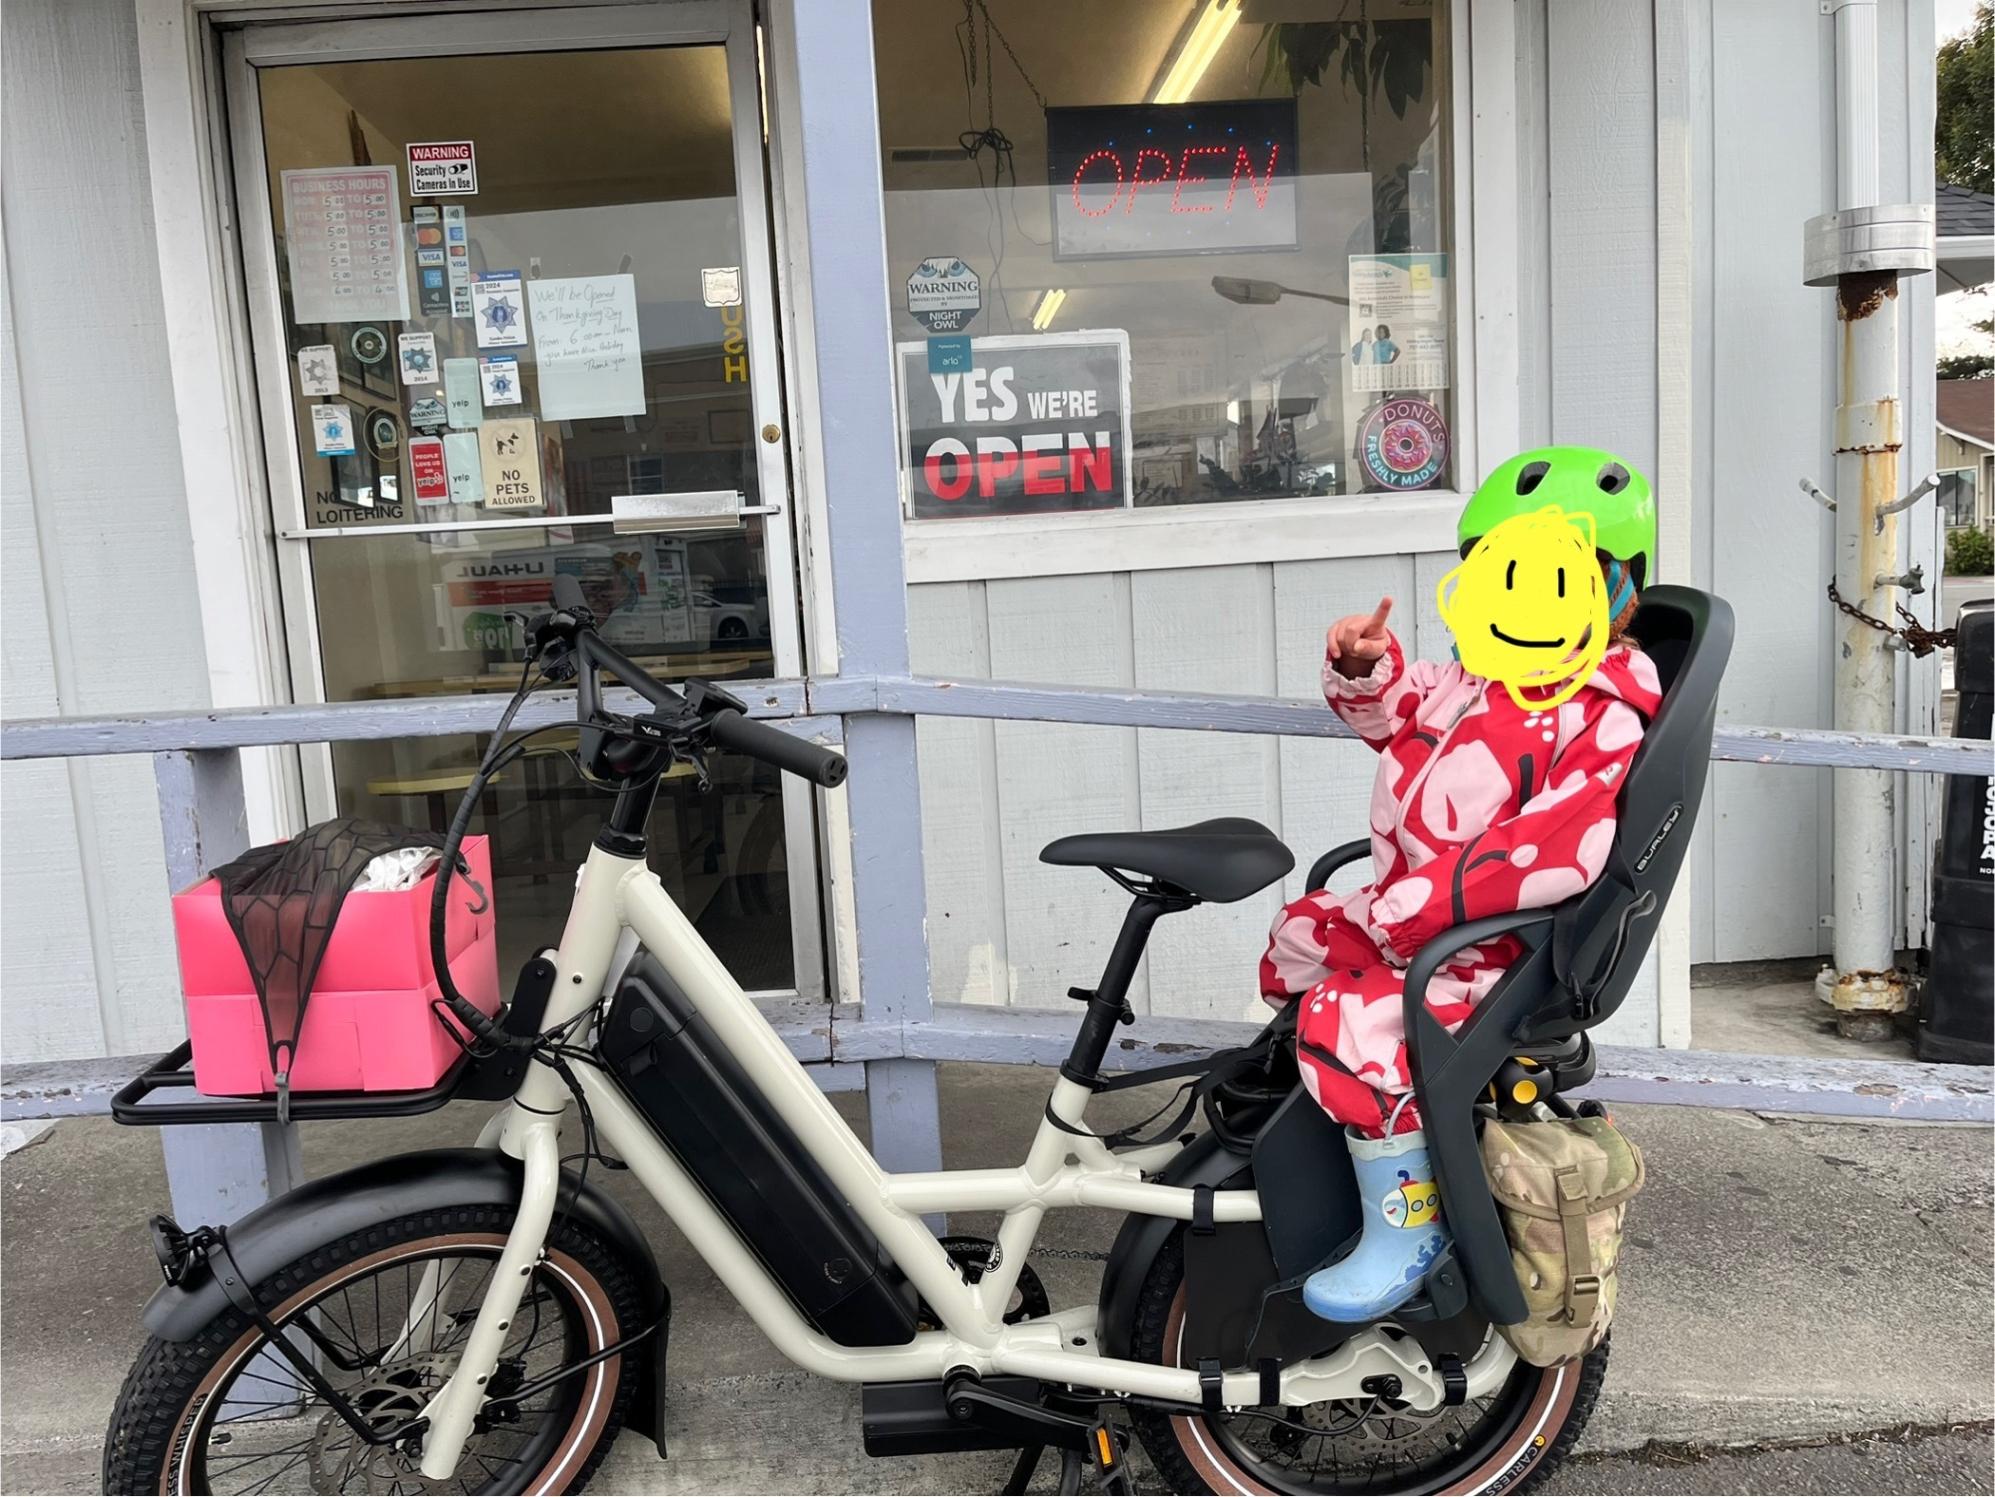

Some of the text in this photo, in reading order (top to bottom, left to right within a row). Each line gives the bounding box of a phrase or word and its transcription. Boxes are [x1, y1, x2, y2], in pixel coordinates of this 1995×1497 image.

[412, 145, 469, 160] WARNING
[415, 164, 446, 177] Security
[292, 178, 386, 193] BUSINESS HOURS
[416, 179, 447, 190] Cameras
[457, 177, 470, 188] Use
[1072, 144, 1279, 217] OPEN
[421, 253, 441, 261] VISA
[451, 260, 467, 268] VISA
[909, 280, 978, 294] WARNING
[929, 311, 962, 321] NIGHT
[933, 320, 959, 330] OWL
[569, 329, 579, 345] 6
[942, 356, 959, 366] arlo
[931, 366, 1098, 424] YES WE'RE
[451, 399, 470, 409] yelp
[1384, 403, 1445, 442] DONUTS
[923, 431, 1113, 501] OPEN
[1367, 435, 1438, 486] FRESHLY MADE
[417, 477, 435, 487] yelp
[452, 473, 470, 483] yelp
[502, 469, 520, 482] NO
[496, 482, 529, 495] PETS
[316, 490, 337, 505] NO
[491, 495, 536, 506] ALLOWED
[316, 505, 404, 524] LOITERING
[1637, 809, 1679, 871] BURLEY
[1486, 1446, 1538, 1496] CARLESS
